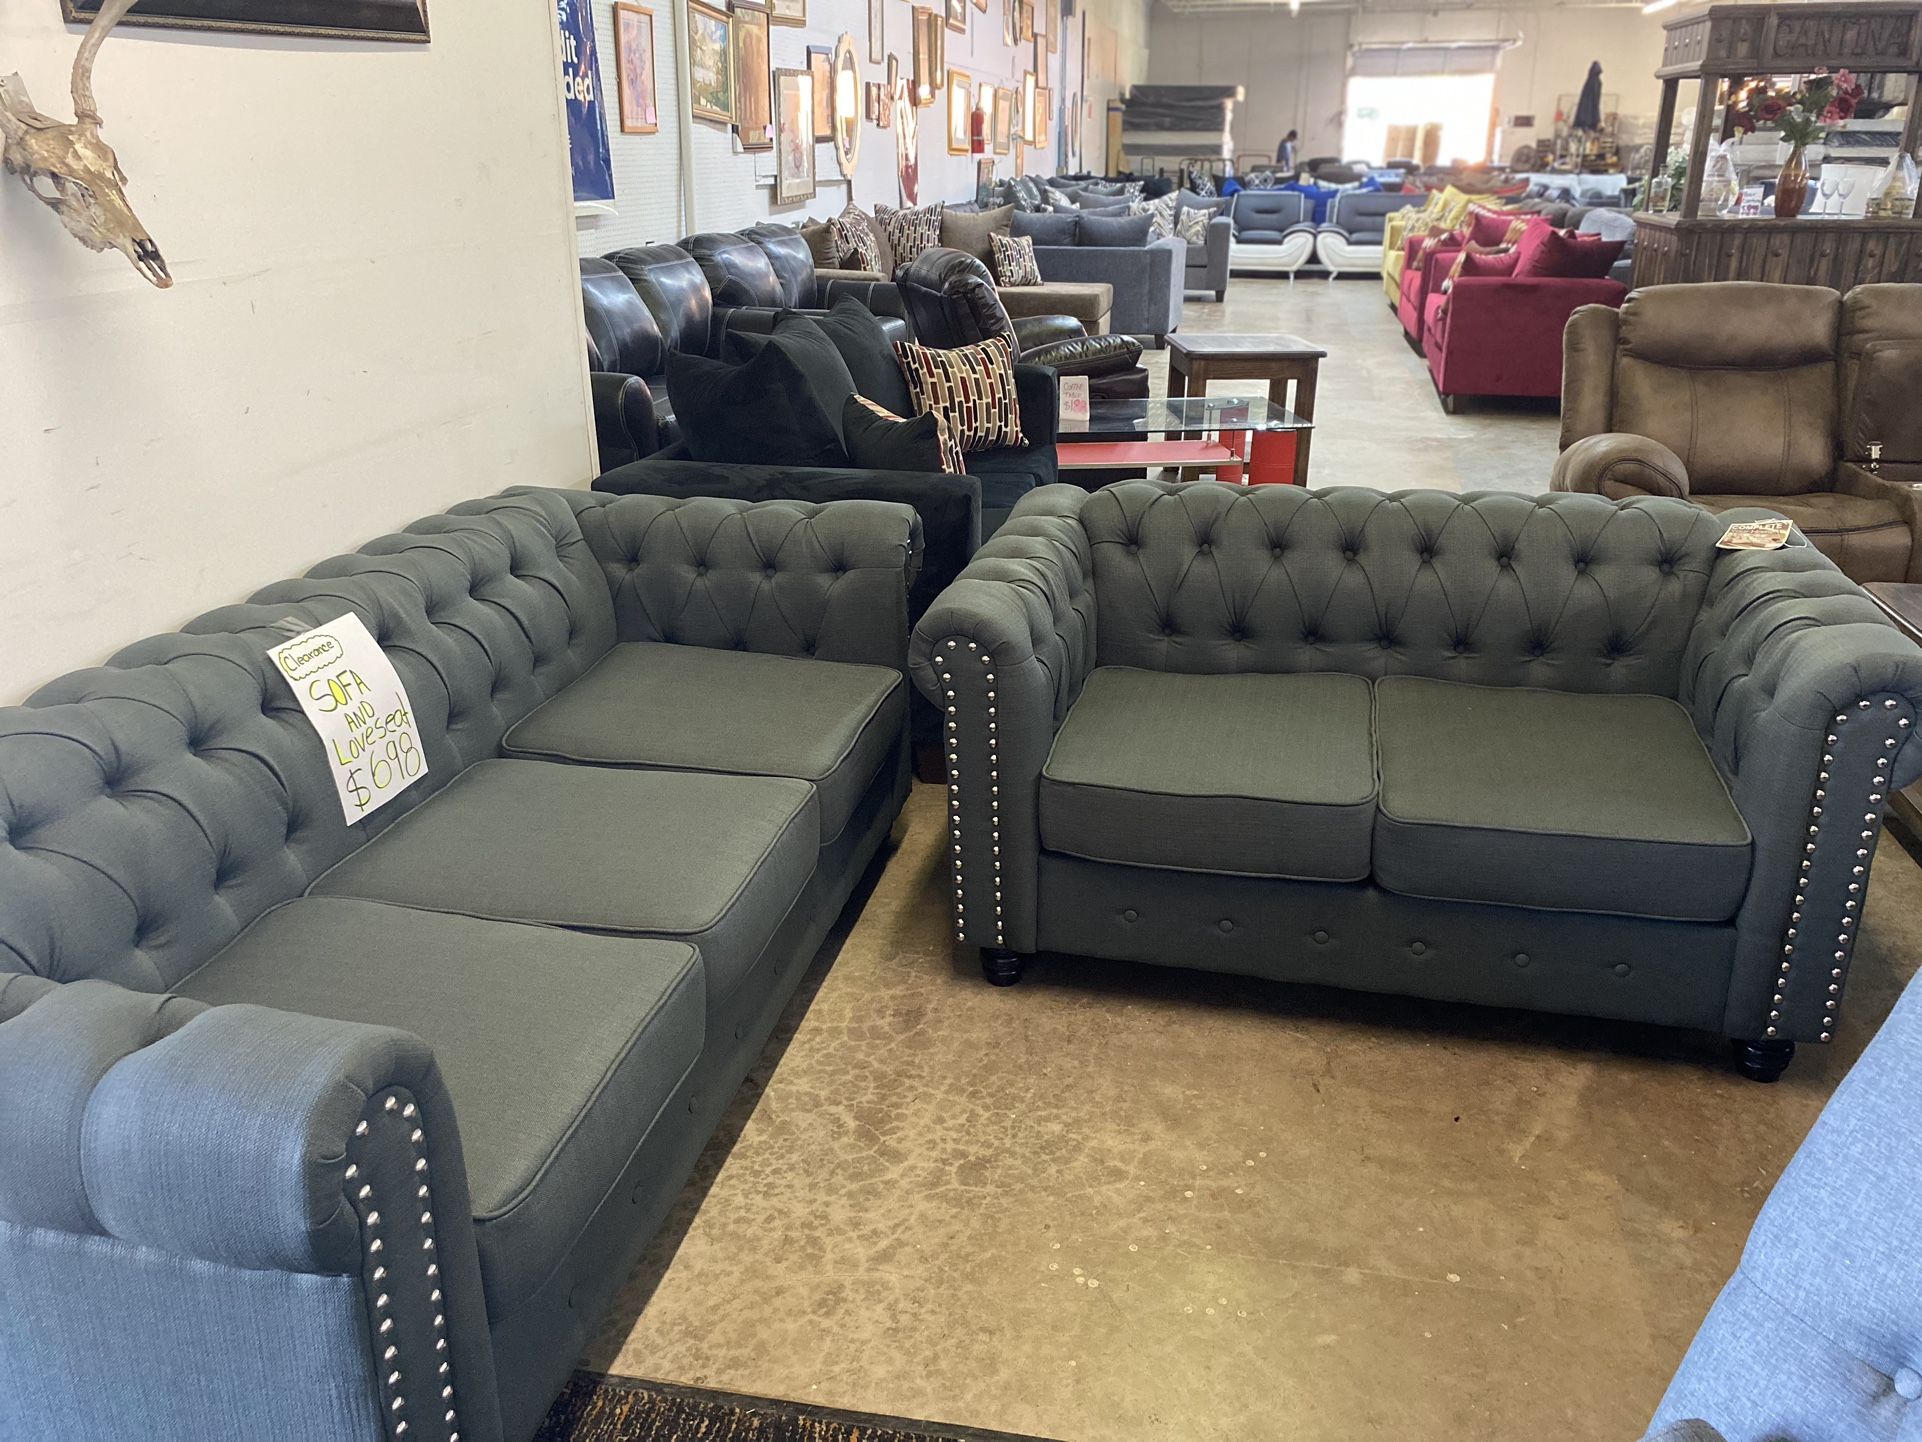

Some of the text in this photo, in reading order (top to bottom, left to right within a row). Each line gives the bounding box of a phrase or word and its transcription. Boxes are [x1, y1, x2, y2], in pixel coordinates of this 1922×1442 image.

[1773, 14, 1907, 57] CANTINA
[1731, 522, 1783, 530] COMPLETE
[282, 639, 334, 672] Clearance
[309, 669, 371, 712] SOFA
[344, 700, 375, 732] AND
[346, 732, 421, 812] $698
